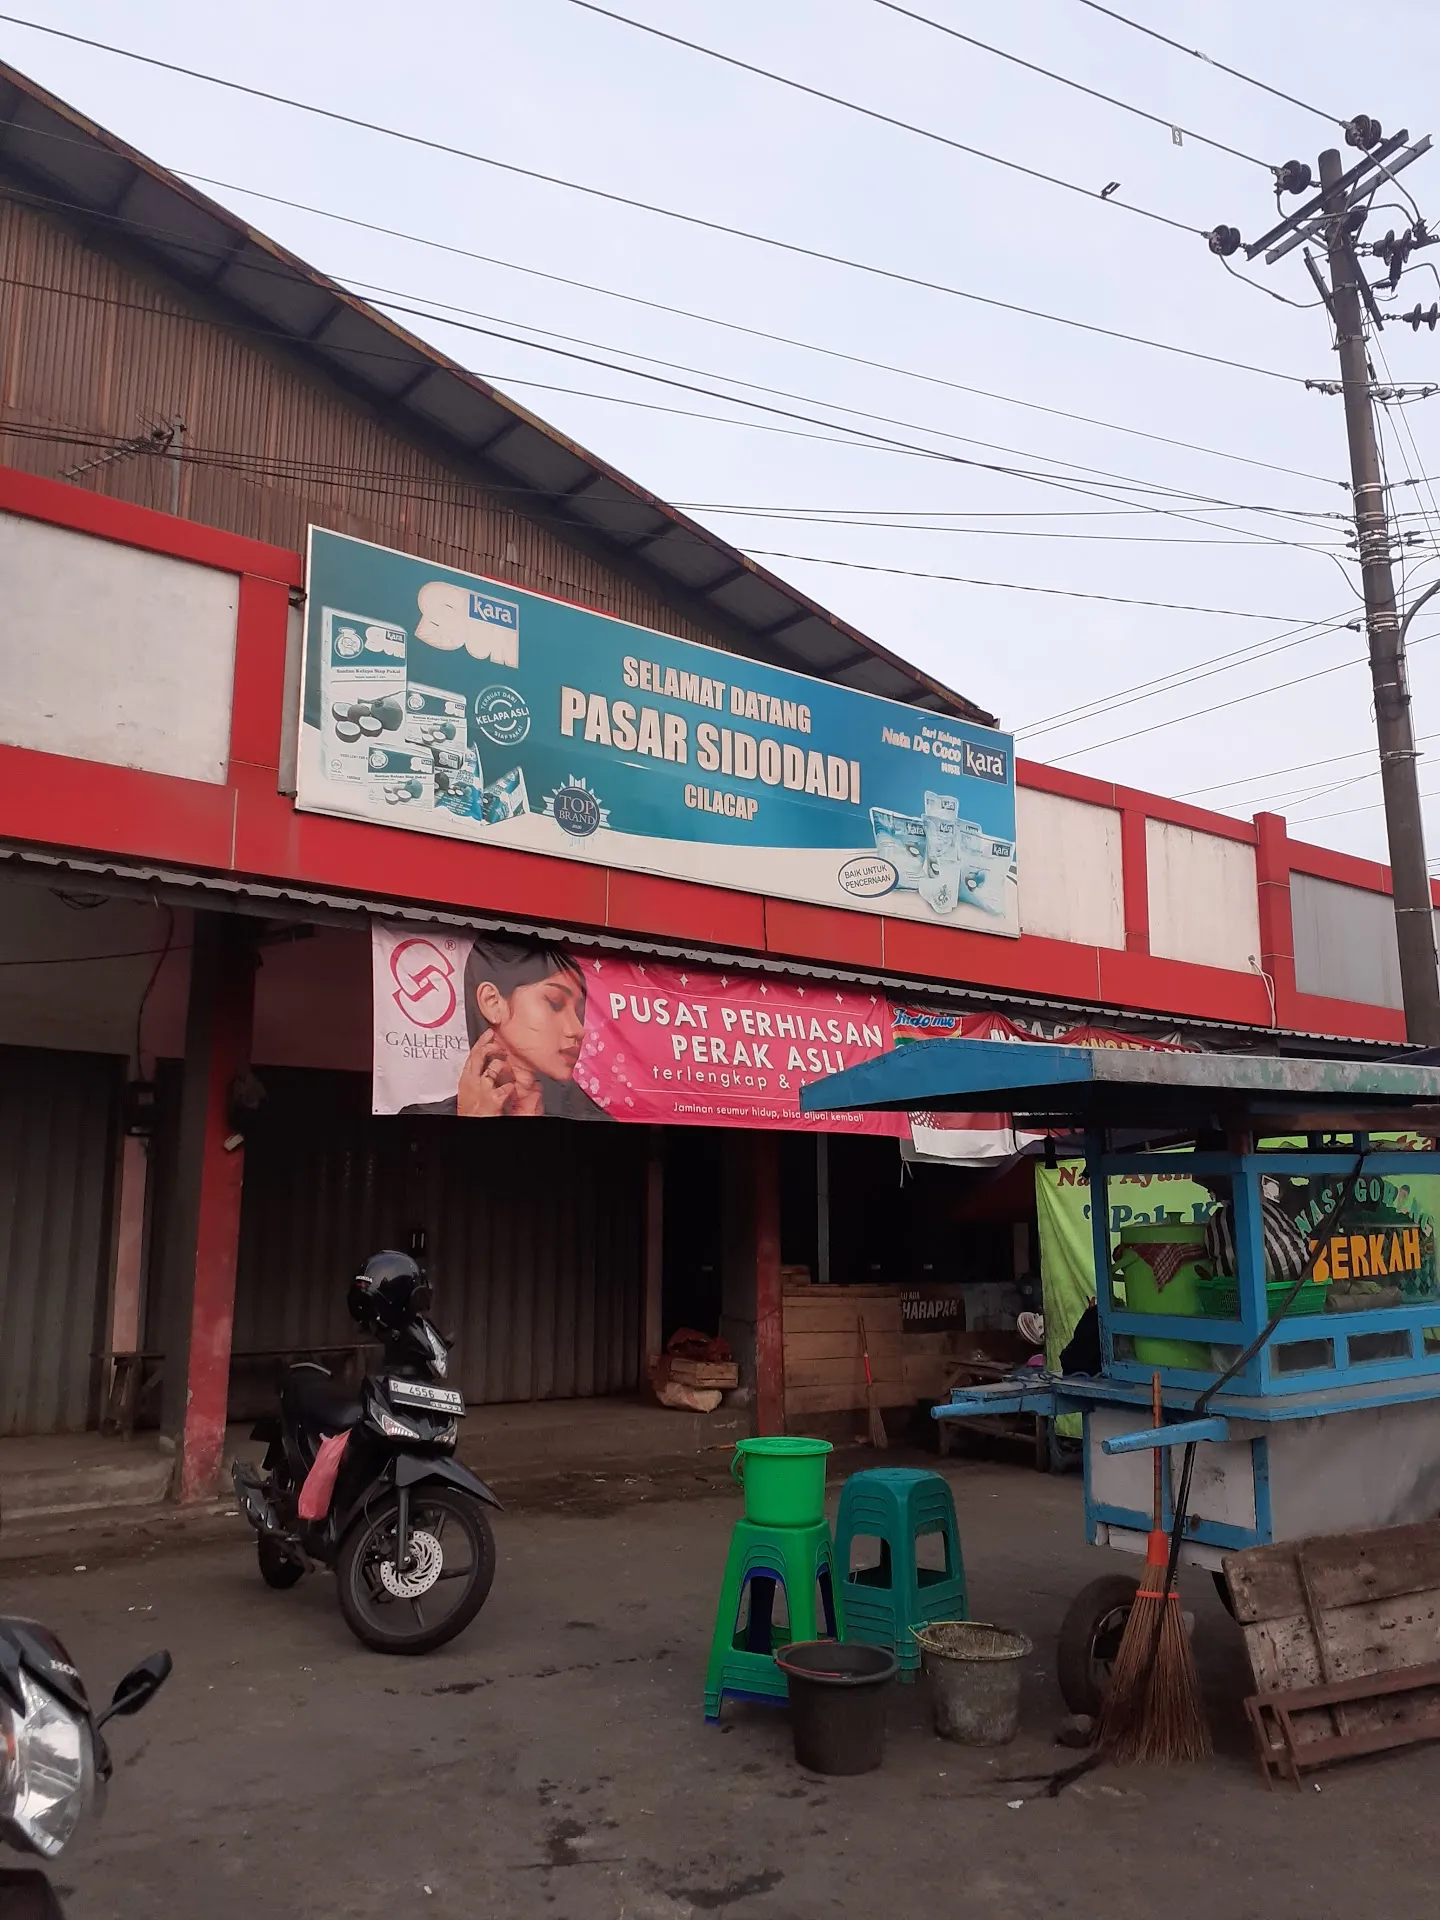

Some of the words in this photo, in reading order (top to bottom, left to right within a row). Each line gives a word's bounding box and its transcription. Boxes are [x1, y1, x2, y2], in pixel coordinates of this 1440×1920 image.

[473, 594, 513, 625] kara
[480, 691, 501, 710] TERBUAT
[502, 691, 518, 703] DARI
[622, 655, 726, 711] SELAMAT
[729, 685, 812, 734] DATANG
[476, 711, 510, 725] KELAPA
[511, 706, 530, 719] ASLI
[494, 730, 509, 740] SIAP
[509, 724, 523, 739] PAKAI
[560, 684, 689, 765] PASAR
[695, 722, 861, 805] SIDODADI
[881, 726, 911, 749] Nata
[912, 735, 931, 754] De
[931, 741, 962, 763] Coco
[965, 743, 1004, 777] kara
[558, 794, 595, 815] TOP
[684, 784, 759, 821] CILACAP
[558, 809, 597, 825] BRAND
[994, 843, 1009, 856] kara
[844, 868, 862, 879] BAIK
[862, 864, 888, 876] UNTUK
[845, 873, 891, 889] PENCERNAAN
[609, 992, 709, 1030] PUSAT
[720, 1006, 885, 1049] PERHIASAN
[385, 1031, 466, 1051] GALLERY
[402, 1046, 449, 1060] SILVER
[670, 1034, 775, 1070] PERAK
[786, 1046, 845, 1075] ASLI
[652, 1065, 768, 1091] terlengkap
[778, 1073, 791, 1089] &
[673, 1101, 714, 1114] Jaminan
[716, 1106, 749, 1116] seumur
[751, 1107, 780, 1120] hidup,
[782, 1109, 801, 1119] bisa
[804, 1112, 829, 1122] dijual
[830, 1111, 865, 1123] kembali
[1308, 1228, 1422, 1283] BERKAH
[392, 1382, 399, 1394] R
[408, 1386, 435, 1399] 4556
[444, 1391, 459, 1404] XF
